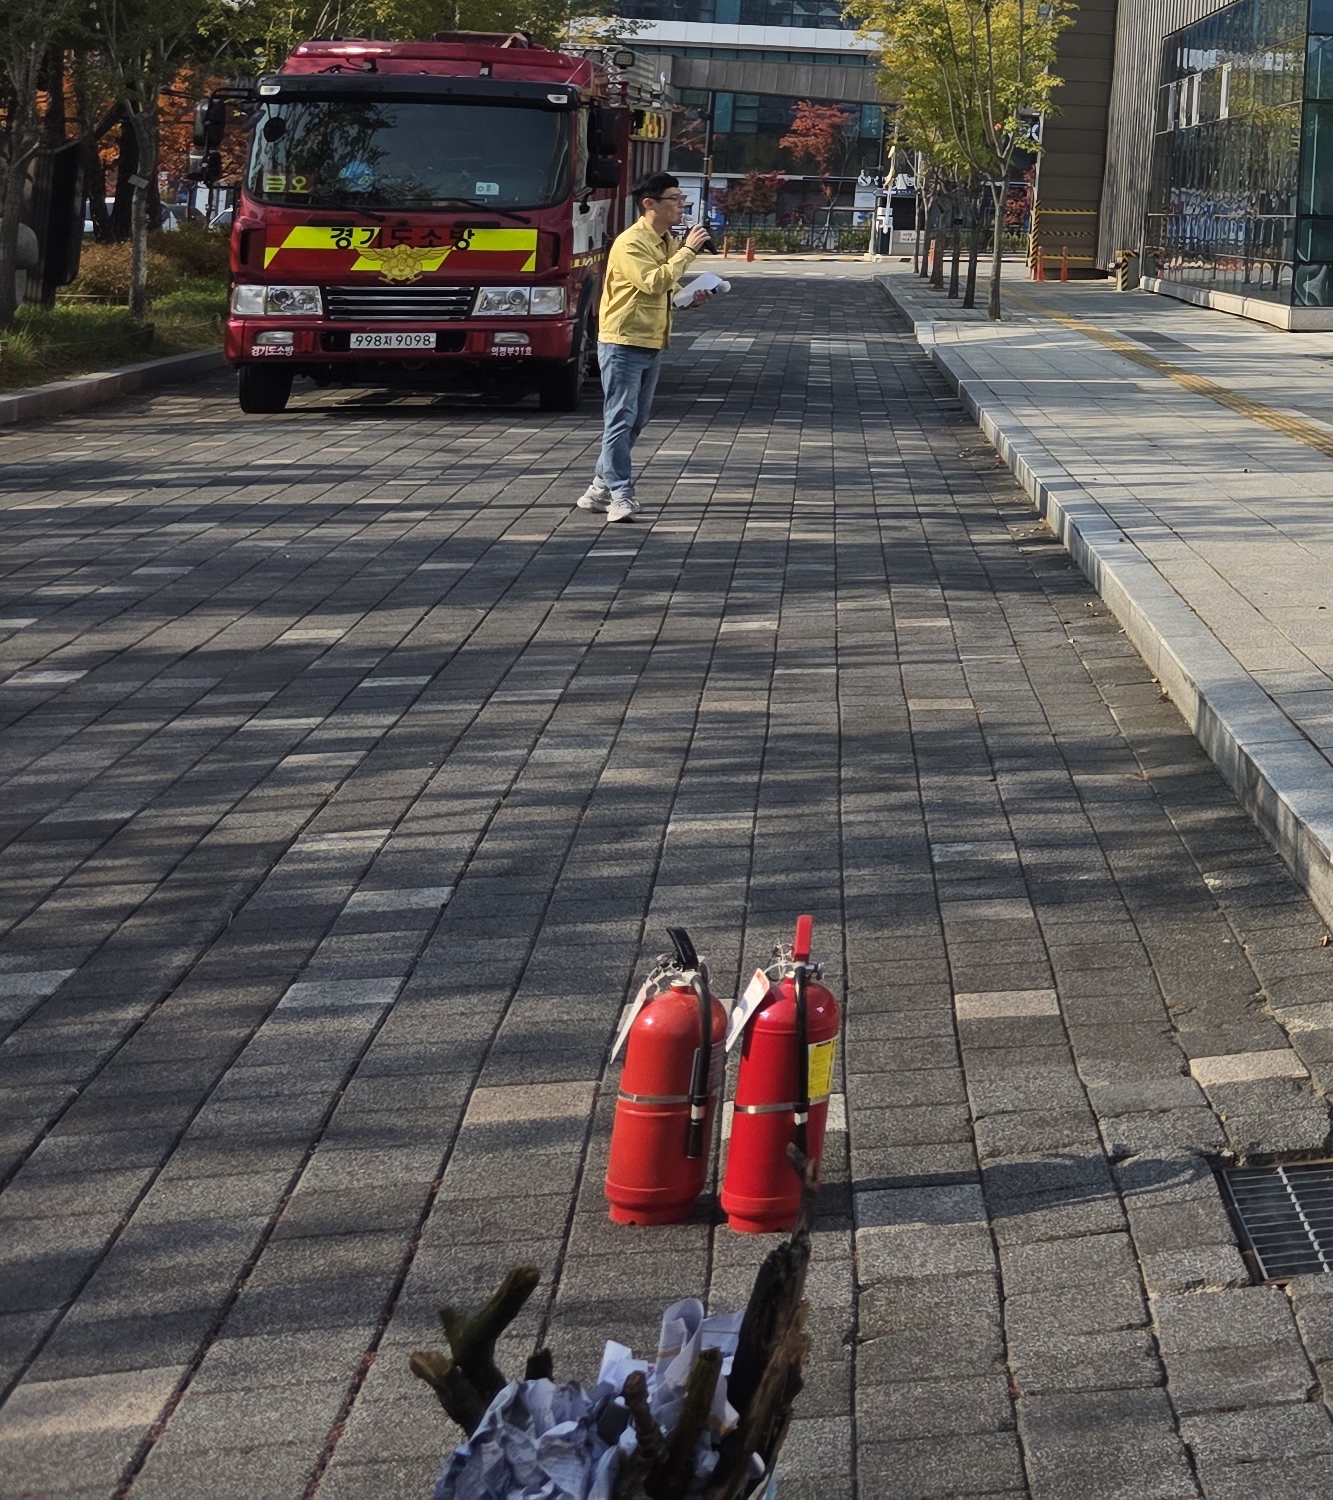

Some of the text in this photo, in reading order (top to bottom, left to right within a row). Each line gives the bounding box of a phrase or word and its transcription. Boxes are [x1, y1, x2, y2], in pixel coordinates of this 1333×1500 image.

[265, 175, 309, 193] 금오
[330, 227, 475, 250] 경기도소방
[395, 334, 431, 346] 9098
[251, 345, 294, 357] 경기도소방
[490, 346, 533, 357] 의정부31호
